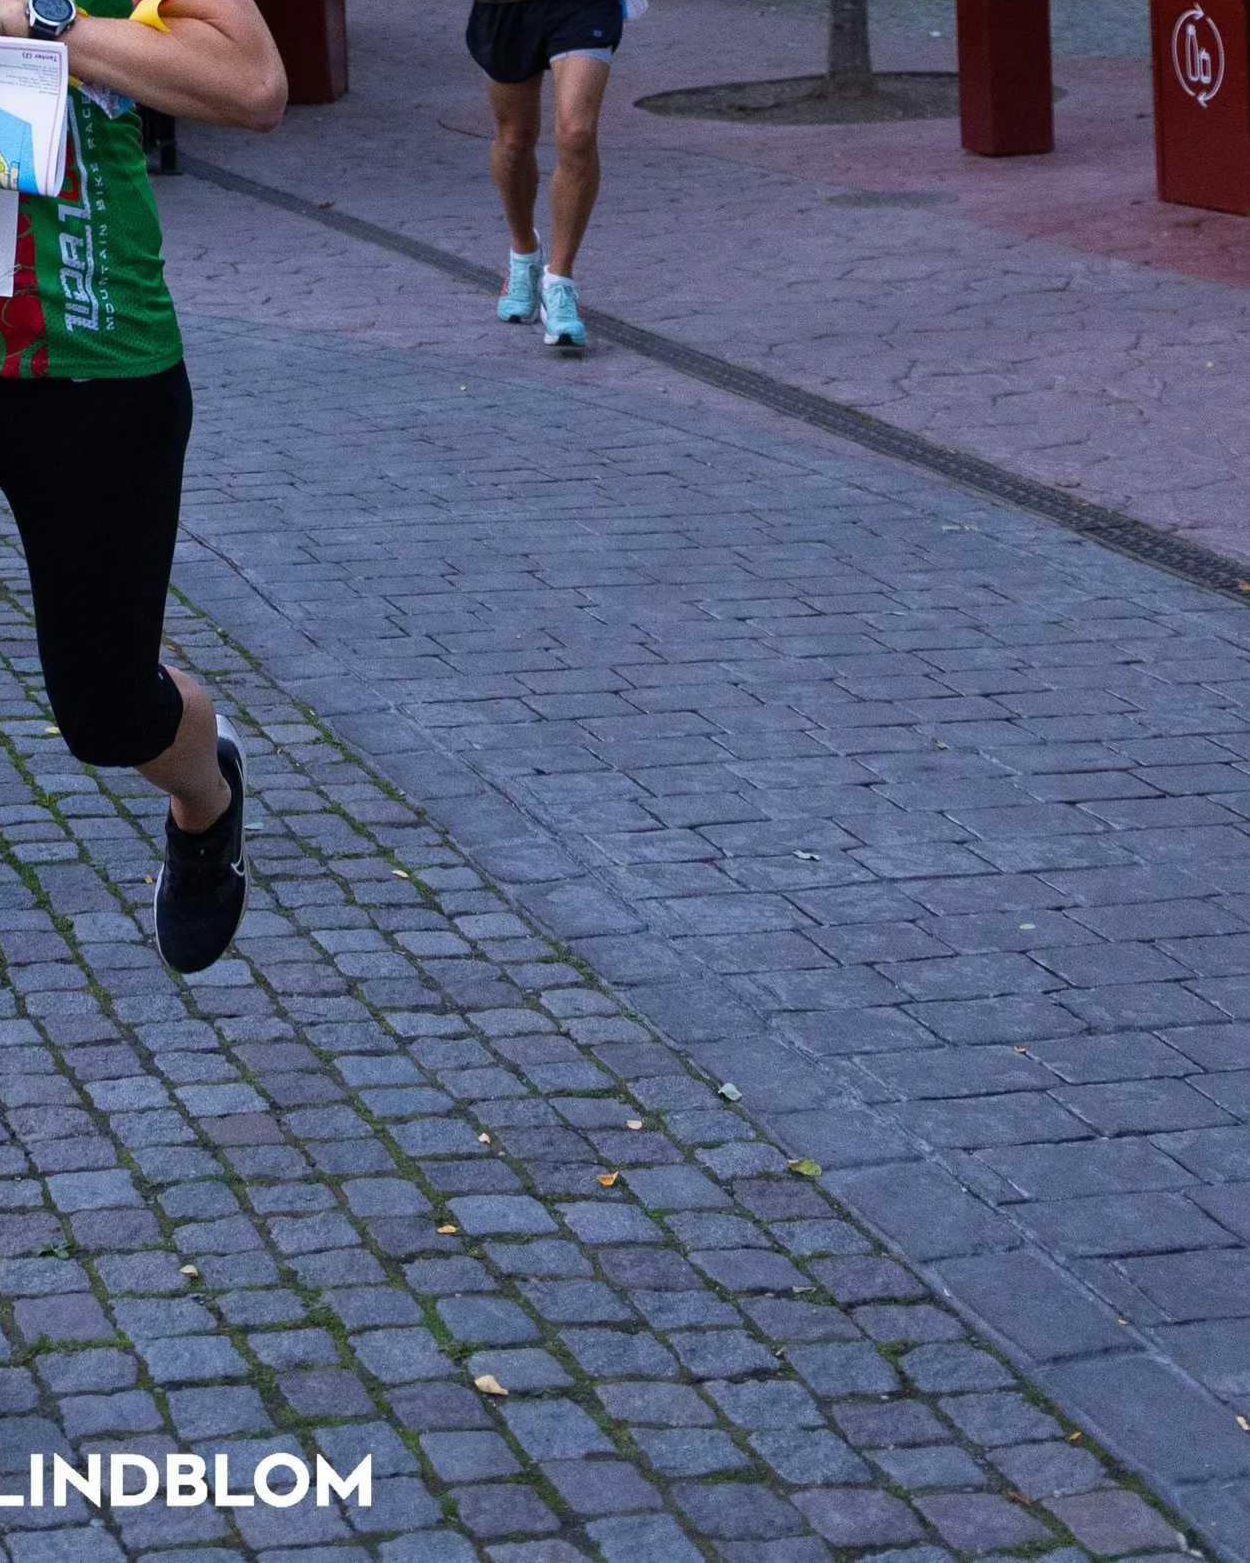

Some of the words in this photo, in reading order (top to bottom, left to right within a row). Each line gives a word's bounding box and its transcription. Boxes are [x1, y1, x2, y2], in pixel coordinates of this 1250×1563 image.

[81, 95, 96, 149] RACE
[90, 163, 106, 211] BIKE
[98, 224, 115, 330] MOUNTAIN
